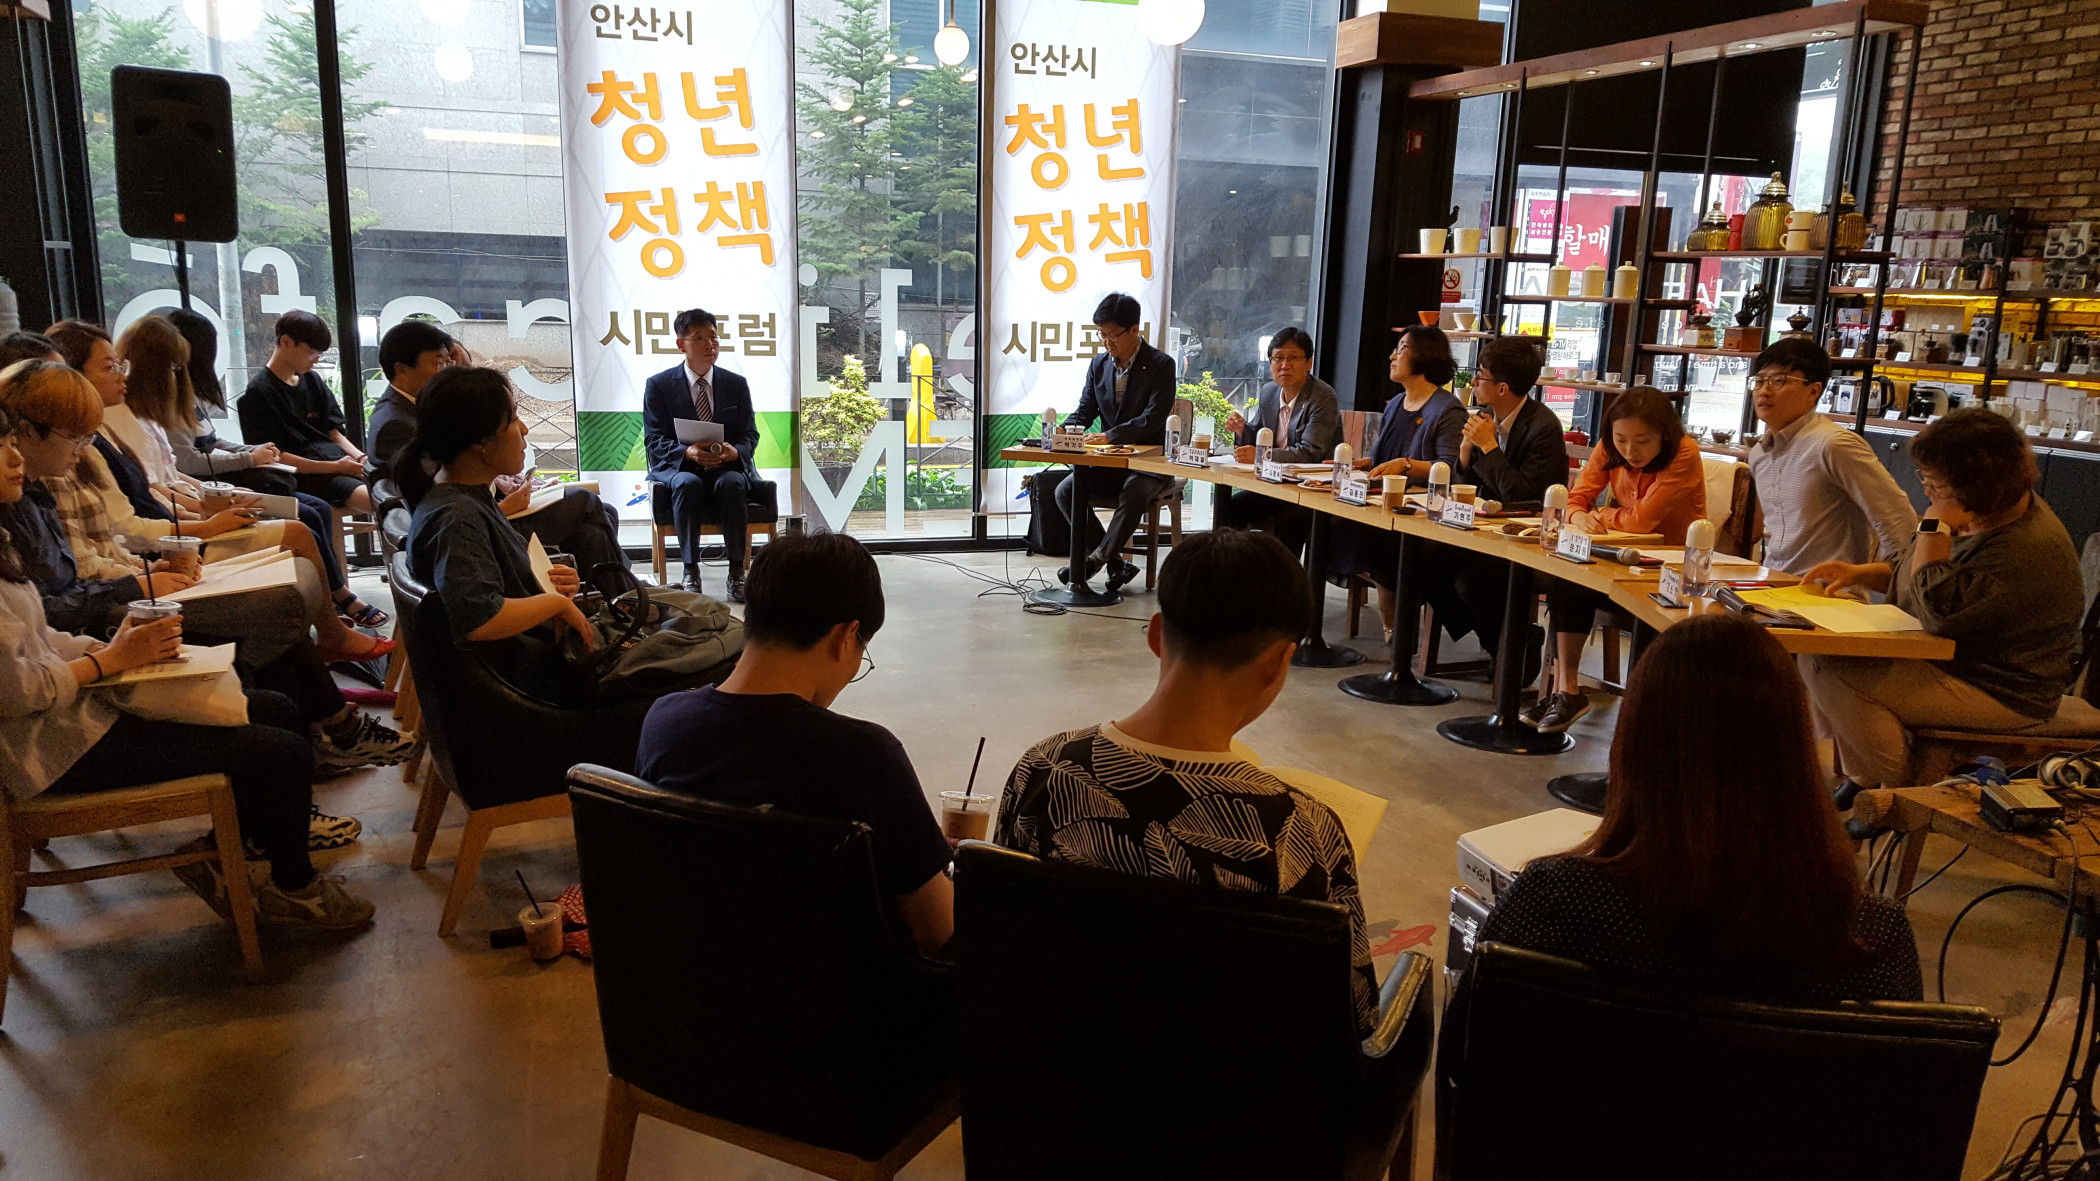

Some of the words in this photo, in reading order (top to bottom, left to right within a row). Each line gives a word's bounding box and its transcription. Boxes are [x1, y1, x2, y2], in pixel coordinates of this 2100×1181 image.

[590, 3, 693, 45] 안산시
[1010, 43, 1097, 79] 안산시
[586, 67, 761, 166] 청년
[1004, 98, 1146, 191] 청년
[604, 180, 776, 280] 정책
[1014, 201, 1154, 294] 정책
[1002, 321, 1150, 363] 시민포
